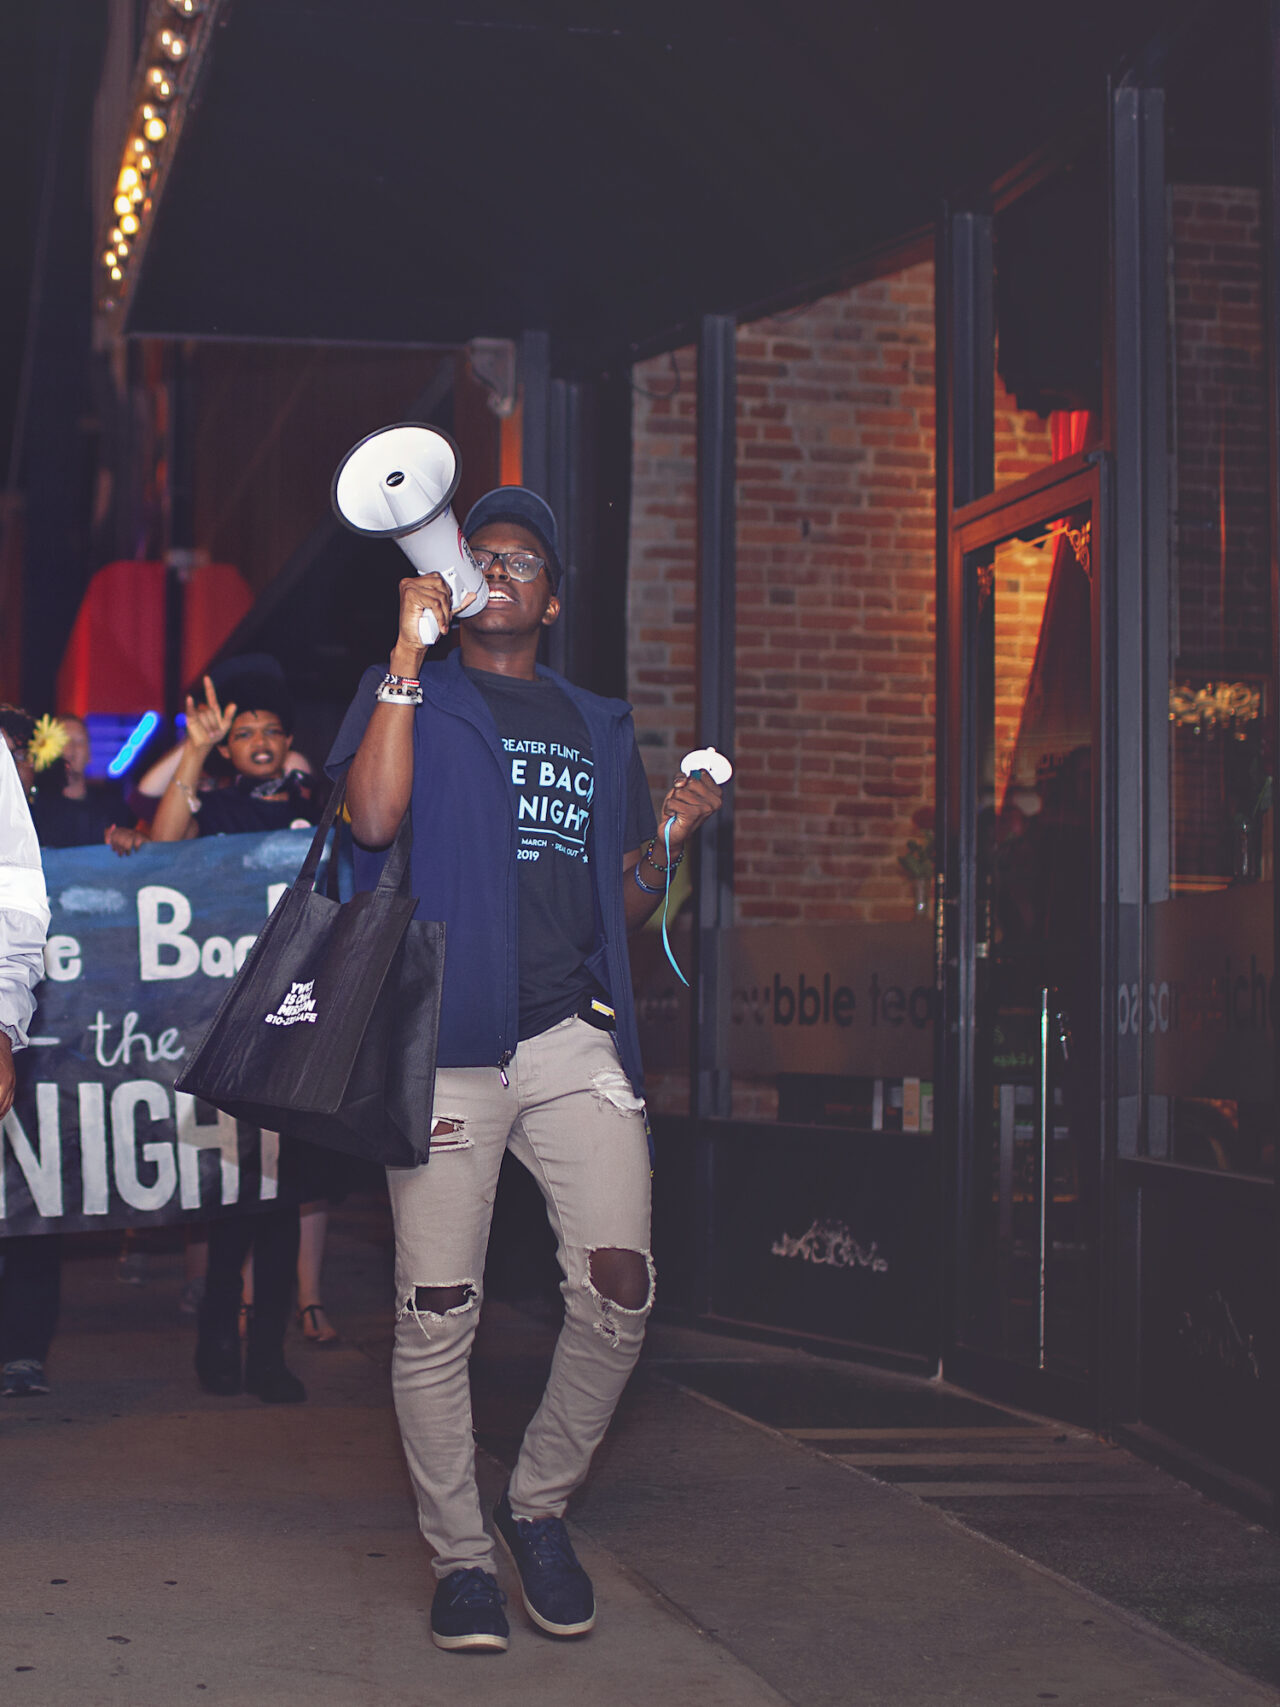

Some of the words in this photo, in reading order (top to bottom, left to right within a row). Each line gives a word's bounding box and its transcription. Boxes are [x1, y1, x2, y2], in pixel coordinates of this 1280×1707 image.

[550, 743, 580, 762] FLINT
[518, 795, 590, 832] NIGHT
[517, 849, 540, 861] 2019
[521, 838, 548, 847] MARCH
[566, 848, 580, 858] OUT
[44, 908, 82, 983] e
[136, 882, 289, 982] Bac
[283, 993, 297, 1005] IS
[88, 1010, 187, 1068] the
